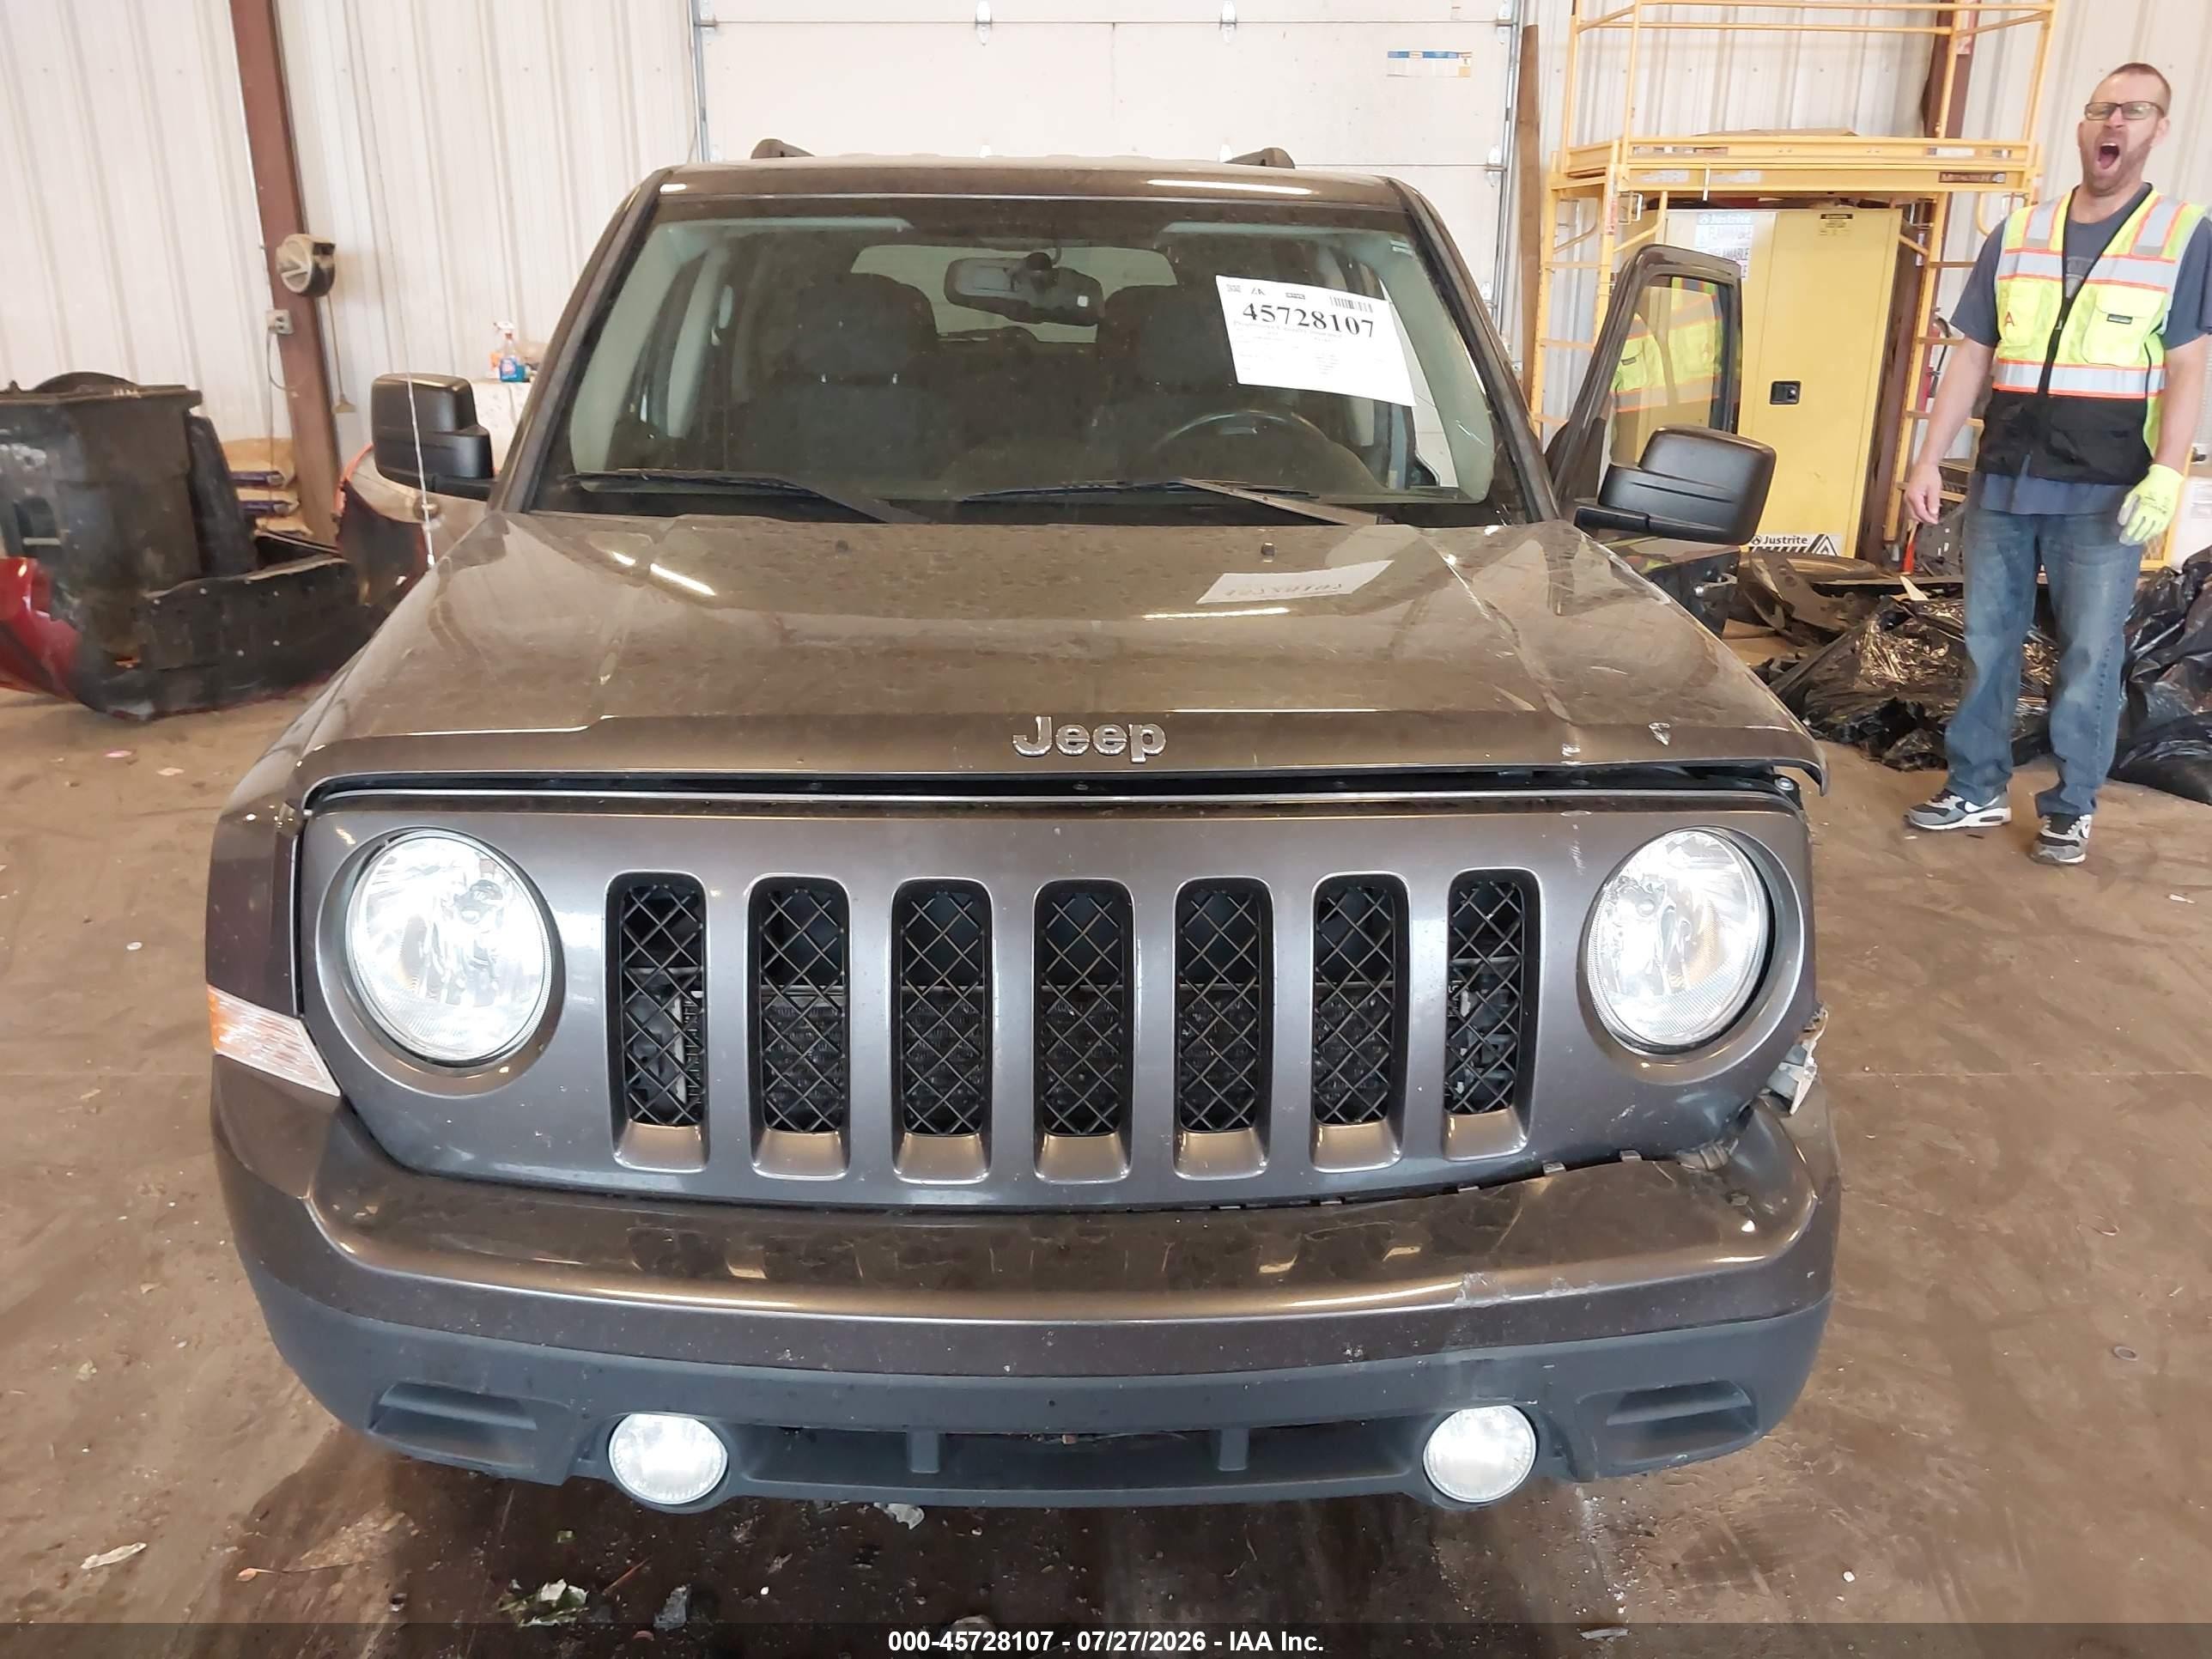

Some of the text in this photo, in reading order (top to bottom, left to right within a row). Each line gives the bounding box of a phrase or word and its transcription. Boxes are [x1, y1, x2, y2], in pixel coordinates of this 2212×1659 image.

[1243, 302, 1374, 337] 45728107
[1763, 535, 1808, 544] Justrite
[1012, 715, 1167, 764] Jeep
